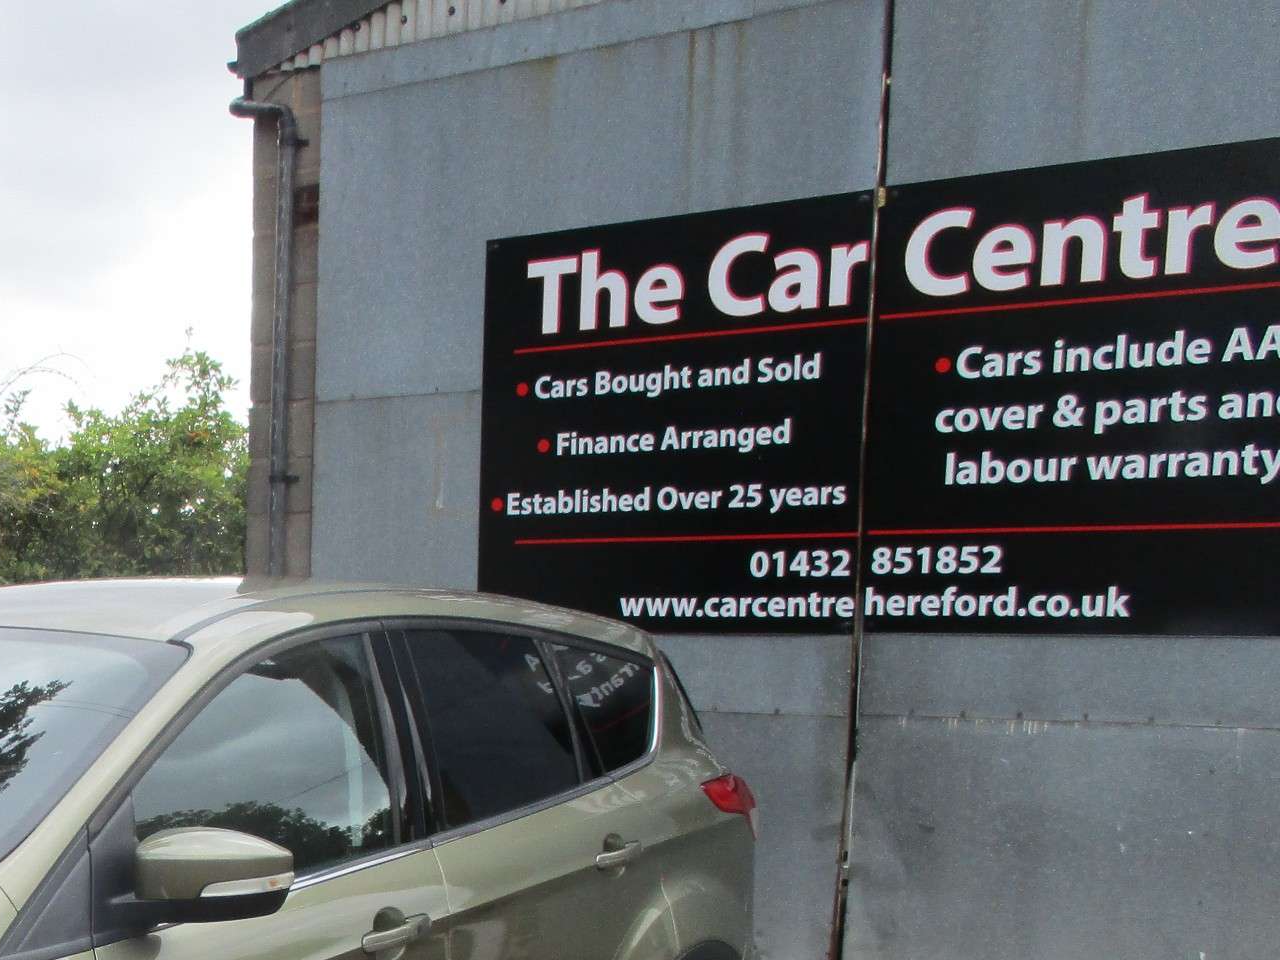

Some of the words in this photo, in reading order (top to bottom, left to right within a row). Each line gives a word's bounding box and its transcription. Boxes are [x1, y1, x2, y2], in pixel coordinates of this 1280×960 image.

[527, 248, 685, 335] The
[707, 232, 869, 317] Car
[904, 193, 1280, 297] Centre
[534, 375, 589, 399] Cars
[594, 364, 692, 398] Bought
[697, 358, 750, 387] and
[757, 352, 821, 383] Sold
[956, 345, 1042, 379] Cars
[1053, 329, 1212, 373] include
[935, 403, 1044, 433] cover
[1052, 394, 1085, 428] &
[1094, 390, 1207, 435] parts
[1218, 390, 1280, 420] an
[556, 431, 655, 456] Finance
[660, 417, 792, 453] Arranged
[944, 450, 1078, 485] labour
[1086, 443, 1280, 485] warranty
[506, 486, 651, 516] Established
[657, 486, 723, 511] Over
[728, 483, 762, 508] 25
[769, 484, 847, 514] years
[749, 549, 851, 578] 01432
[871, 545, 1003, 575] 851852
